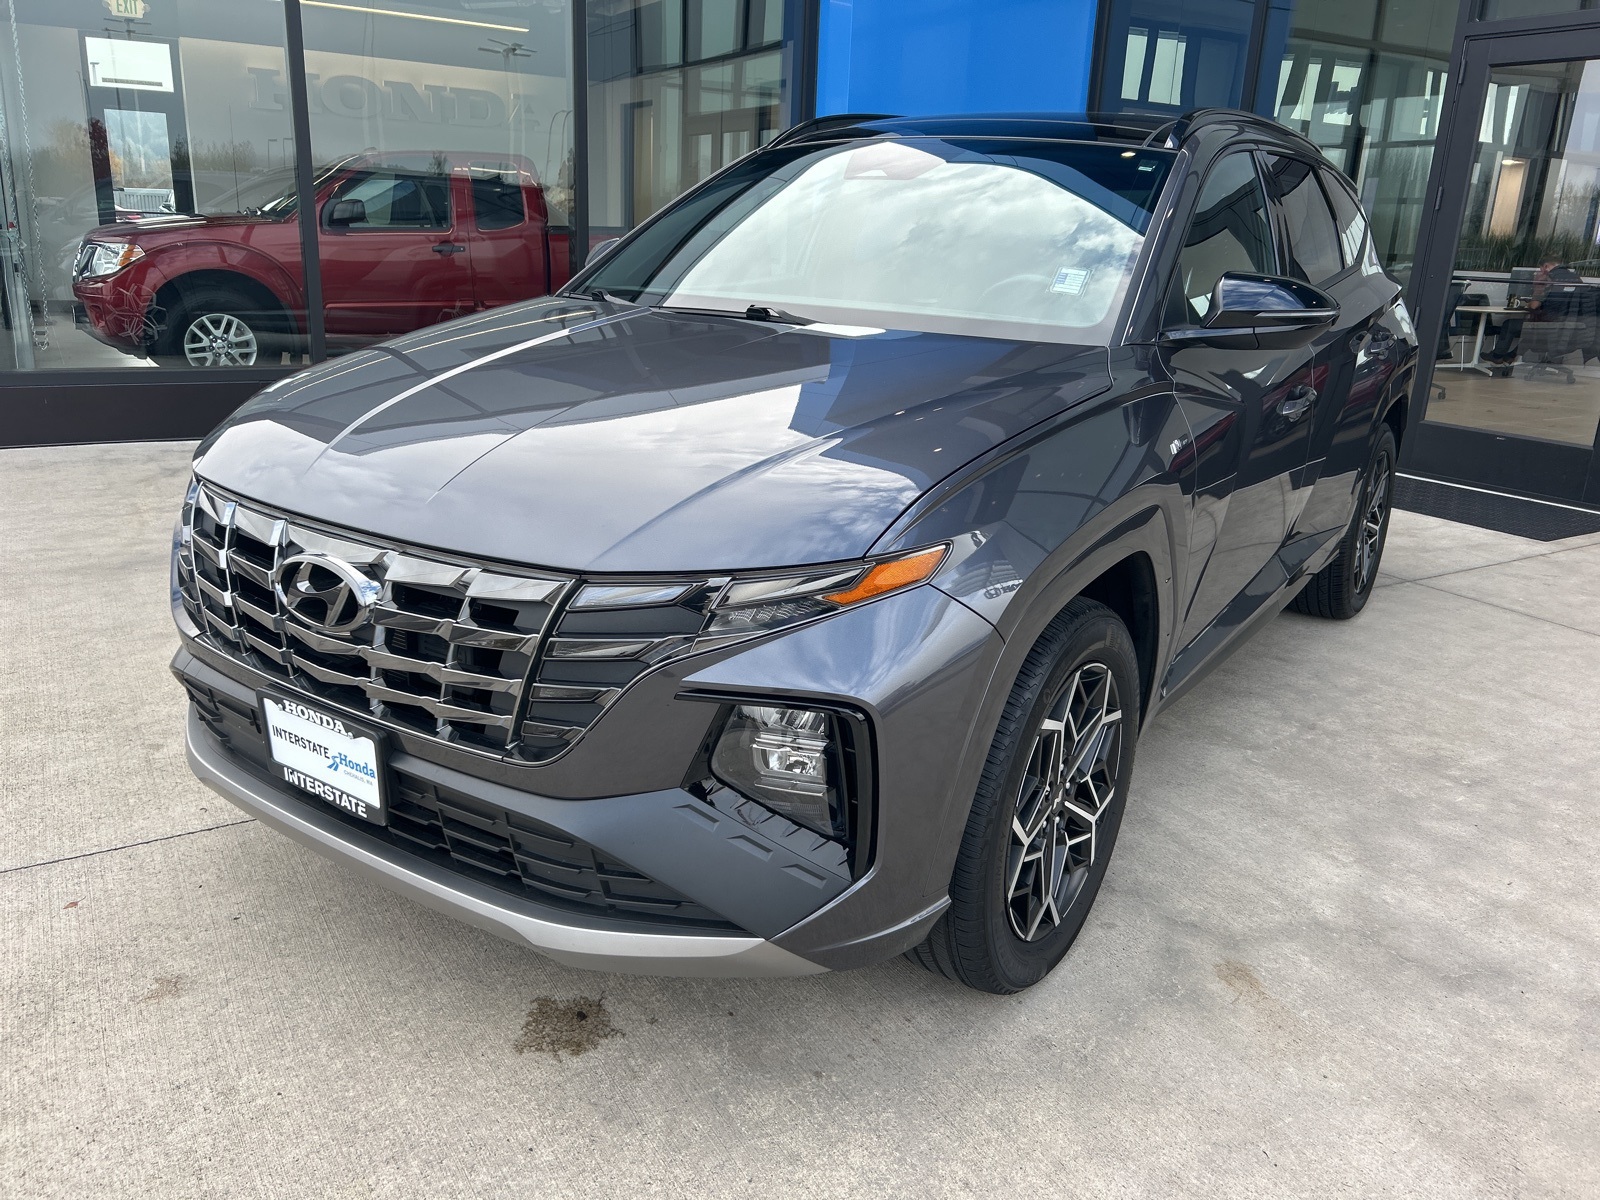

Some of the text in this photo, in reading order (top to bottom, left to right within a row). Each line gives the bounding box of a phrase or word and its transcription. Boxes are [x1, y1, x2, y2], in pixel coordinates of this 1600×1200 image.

[116, 0, 137, 14] EXIT
[247, 67, 542, 132] HONDA
[283, 700, 346, 734] HONDA
[272, 725, 376, 778] INTERSTATE Honda
[284, 767, 367, 818] INTERSTATE
